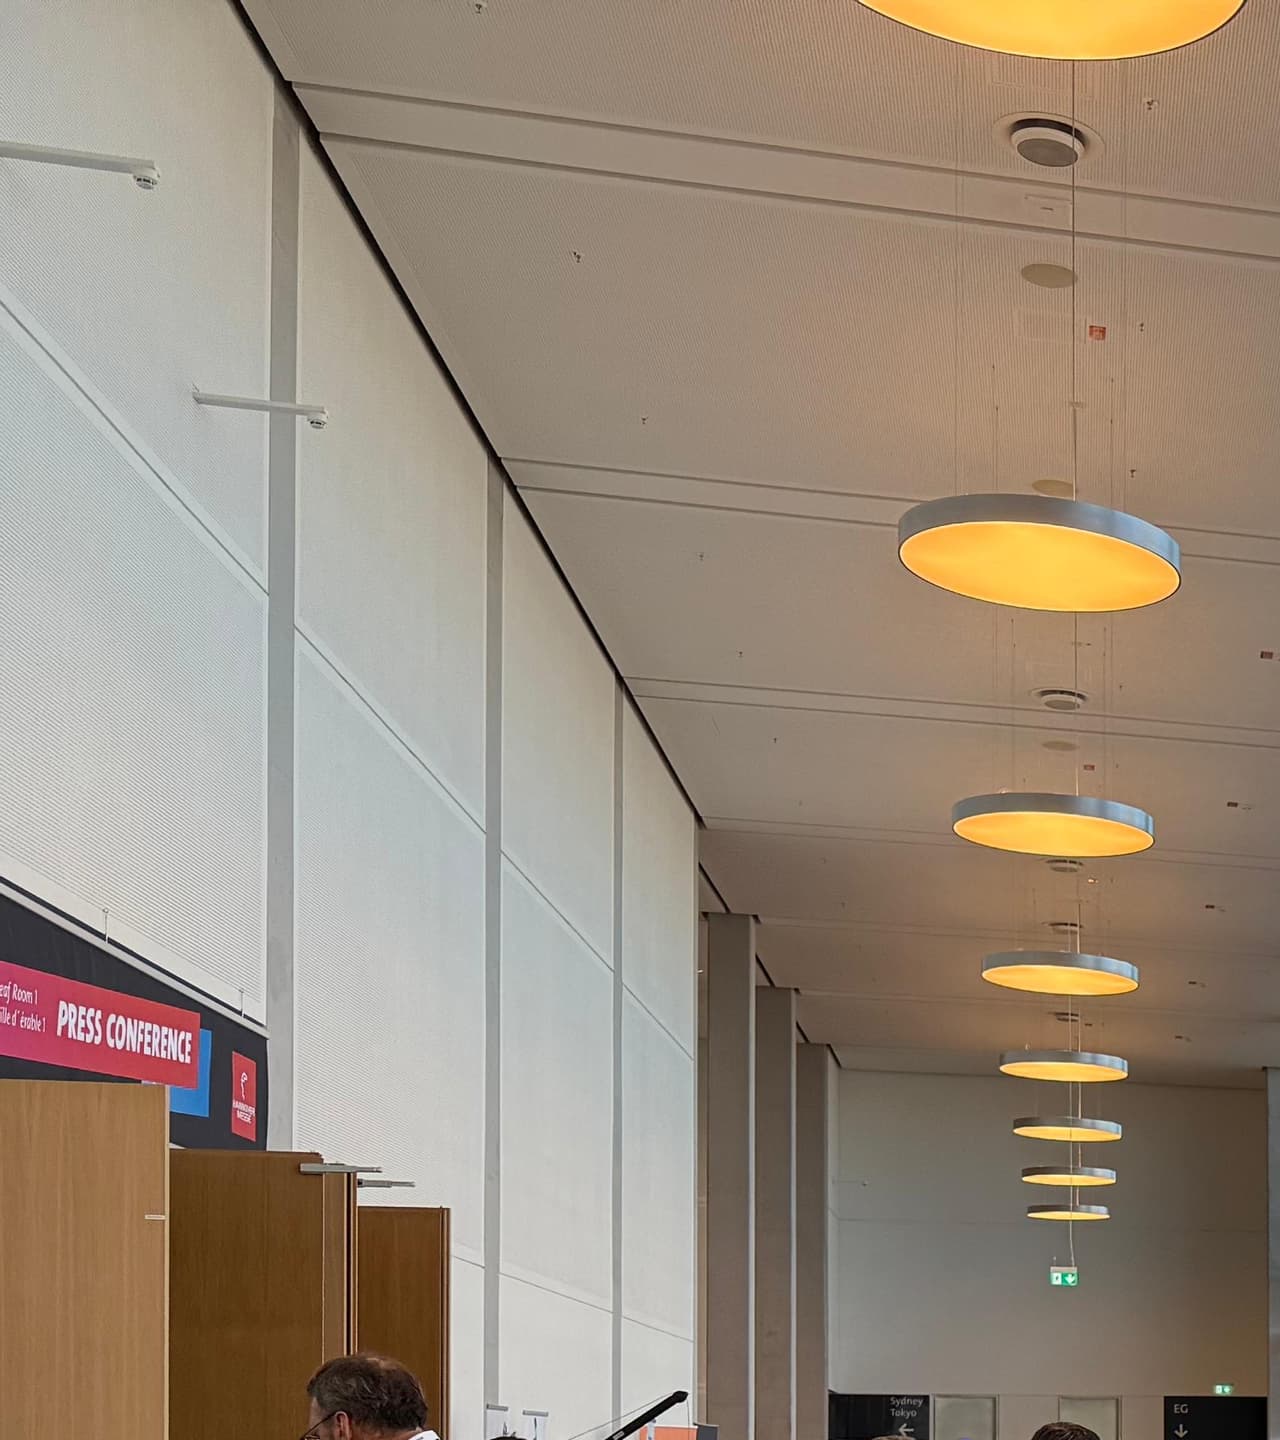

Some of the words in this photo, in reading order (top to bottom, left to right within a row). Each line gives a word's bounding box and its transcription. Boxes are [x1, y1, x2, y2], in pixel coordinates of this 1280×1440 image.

[56, 1000, 103, 1046] PRESS
[106, 1013, 193, 1065] CONFERENCE
[889, 1396, 924, 1408] Sydney
[889, 1408, 917, 1420] Tokyo
[1173, 1403, 1189, 1414] EG
